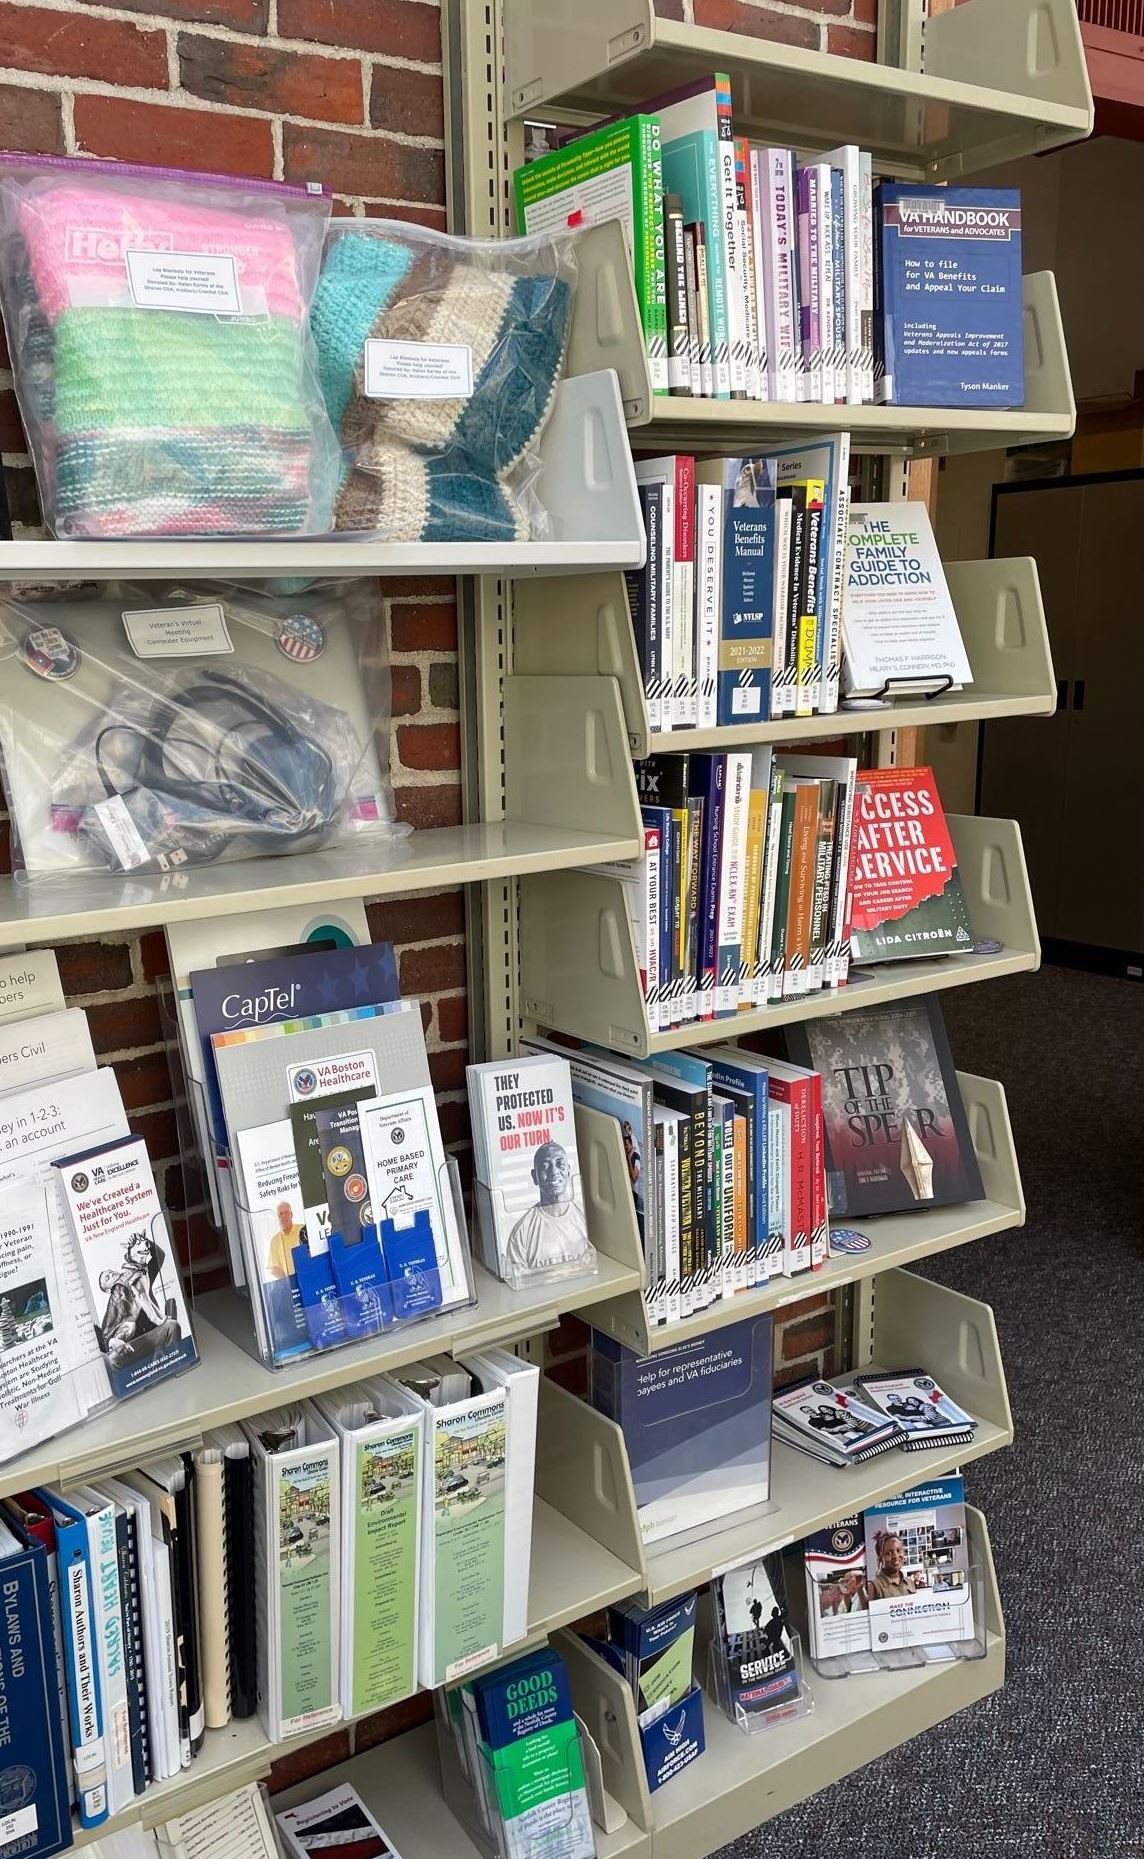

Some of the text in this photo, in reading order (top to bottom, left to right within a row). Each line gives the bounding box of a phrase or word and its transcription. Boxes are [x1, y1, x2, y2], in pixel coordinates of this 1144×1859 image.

[708, 158, 720, 239] EVERYTHING
[652, 125, 666, 304] DO WHAT YOU ARE
[724, 155, 736, 272] Get Together
[923, 210, 1010, 227] HANDBOOK
[914, 226, 950, 234] VETERANS
[950, 226, 964, 234] and
[964, 227, 1006, 236] ADVOCATES
[775, 186, 790, 318] TODAY'S MILITARY
[905, 260, 958, 268] How file
[906, 271, 976, 281] for Benefits
[714, 278, 724, 314] REMOTE
[906, 282, 1006, 294] and Appeal Your Claim
[904, 322, 936, 331] including
[904, 348, 930, 356] updates
[960, 382, 1010, 392] Tyson Manker
[782, 461, 802, 472] Series
[863, 521, 890, 532] THE
[733, 520, 767, 556] Veterans Benefits Manual
[793, 512, 804, 581] Medical Evidence
[847, 532, 920, 546] OMPLETE
[856, 546, 908, 560] FAMILY
[806, 512, 820, 614] Veterans Benefits
[850, 560, 898, 572] GUIDE
[706, 546, 714, 614] DESERVE
[830, 490, 846, 665] ASSOCIATE CONTRACT SPECIALIST
[848, 571, 932, 586] ADDICTION
[165, 628, 192, 636] Meeting
[146, 638, 179, 646] Computer
[730, 645, 766, 656] 2021-2022
[736, 656, 758, 664] EDITION
[860, 790, 934, 820] CCESS
[712, 806, 720, 830] Nursing
[858, 820, 926, 850] AFTER
[822, 840, 834, 902] TREATING PTSD
[854, 846, 947, 882] SERVICE
[649, 876, 657, 900] YOUR
[690, 862, 698, 909] FORWARD
[812, 840, 827, 942] MILITARY PERSONNEL
[708, 904, 716, 920] Prep
[866, 905, 892, 913] MILITARY
[876, 926, 952, 946] LIDA CITROËN
[9, 972, 36, 986] help
[20, 1042, 46, 1058] Civil
[332, 1060, 365, 1075] Boston
[319, 1069, 371, 1088] Healthcare
[494, 1073, 520, 1092] THEY
[726, 1074, 745, 1088] Profile
[834, 1064, 894, 1100] TIP
[496, 1088, 554, 1112] PROTECTED
[867, 1097, 894, 1112] THE
[498, 1106, 565, 1132] US. NOW IT'S
[21, 1120, 66, 1144] account
[500, 1134, 521, 1152] OUR
[106, 1159, 140, 1176] EXCELLENCE
[377, 1150, 425, 1168] HOME BASED
[694, 1112, 705, 1220] BEYOND MILITARY
[386, 1162, 418, 1176] PRIMARY
[394, 1172, 414, 1184] CARE
[258, 1174, 282, 1188] Reducing
[76, 1183, 134, 1212] We've Created
[260, 1184, 290, 1198] Safety Risks
[80, 1188, 153, 1222] Healthcare System
[724, 1186, 734, 1242] UNIFORM
[0, 1223, 34, 1240] 1990-1991
[82, 1216, 112, 1234] Just for
[4, 1234, 33, 1248] Veteran
[18, 1350, 54, 1370] Healthcare
[30, 1358, 59, 1374] Studying
[658, 1368, 671, 1378] for
[672, 1350, 733, 1374] representative
[668, 1372, 684, 1386] and
[700, 1356, 743, 1376] fiduciaries
[0, 1388, 37, 1409] Treatments
[14, 1392, 51, 1412] War Illness
[436, 1400, 505, 1428] Sharon Commons
[364, 1432, 414, 1450] Sharon Commons
[281, 1458, 328, 1476] Sharon Commons
[905, 1488, 944, 1498] INTERACTIVE
[922, 1492, 952, 1502] VETERANS
[367, 1511, 406, 1528] Environmental
[890, 1602, 951, 1618] CONNECTION
[2, 1580, 25, 1678] BYLAWS AND
[72, 1569, 94, 1738] Sharon Authors and Their Works
[740, 1650, 786, 1680] SERVICE
[506, 1670, 553, 1700] GOOD
[506, 1686, 558, 1720] DEEDS
[304, 1707, 334, 1722] Reference
[676, 1738, 690, 1754] HIGH
[657, 1740, 698, 1776] AIRFORCE.COM
